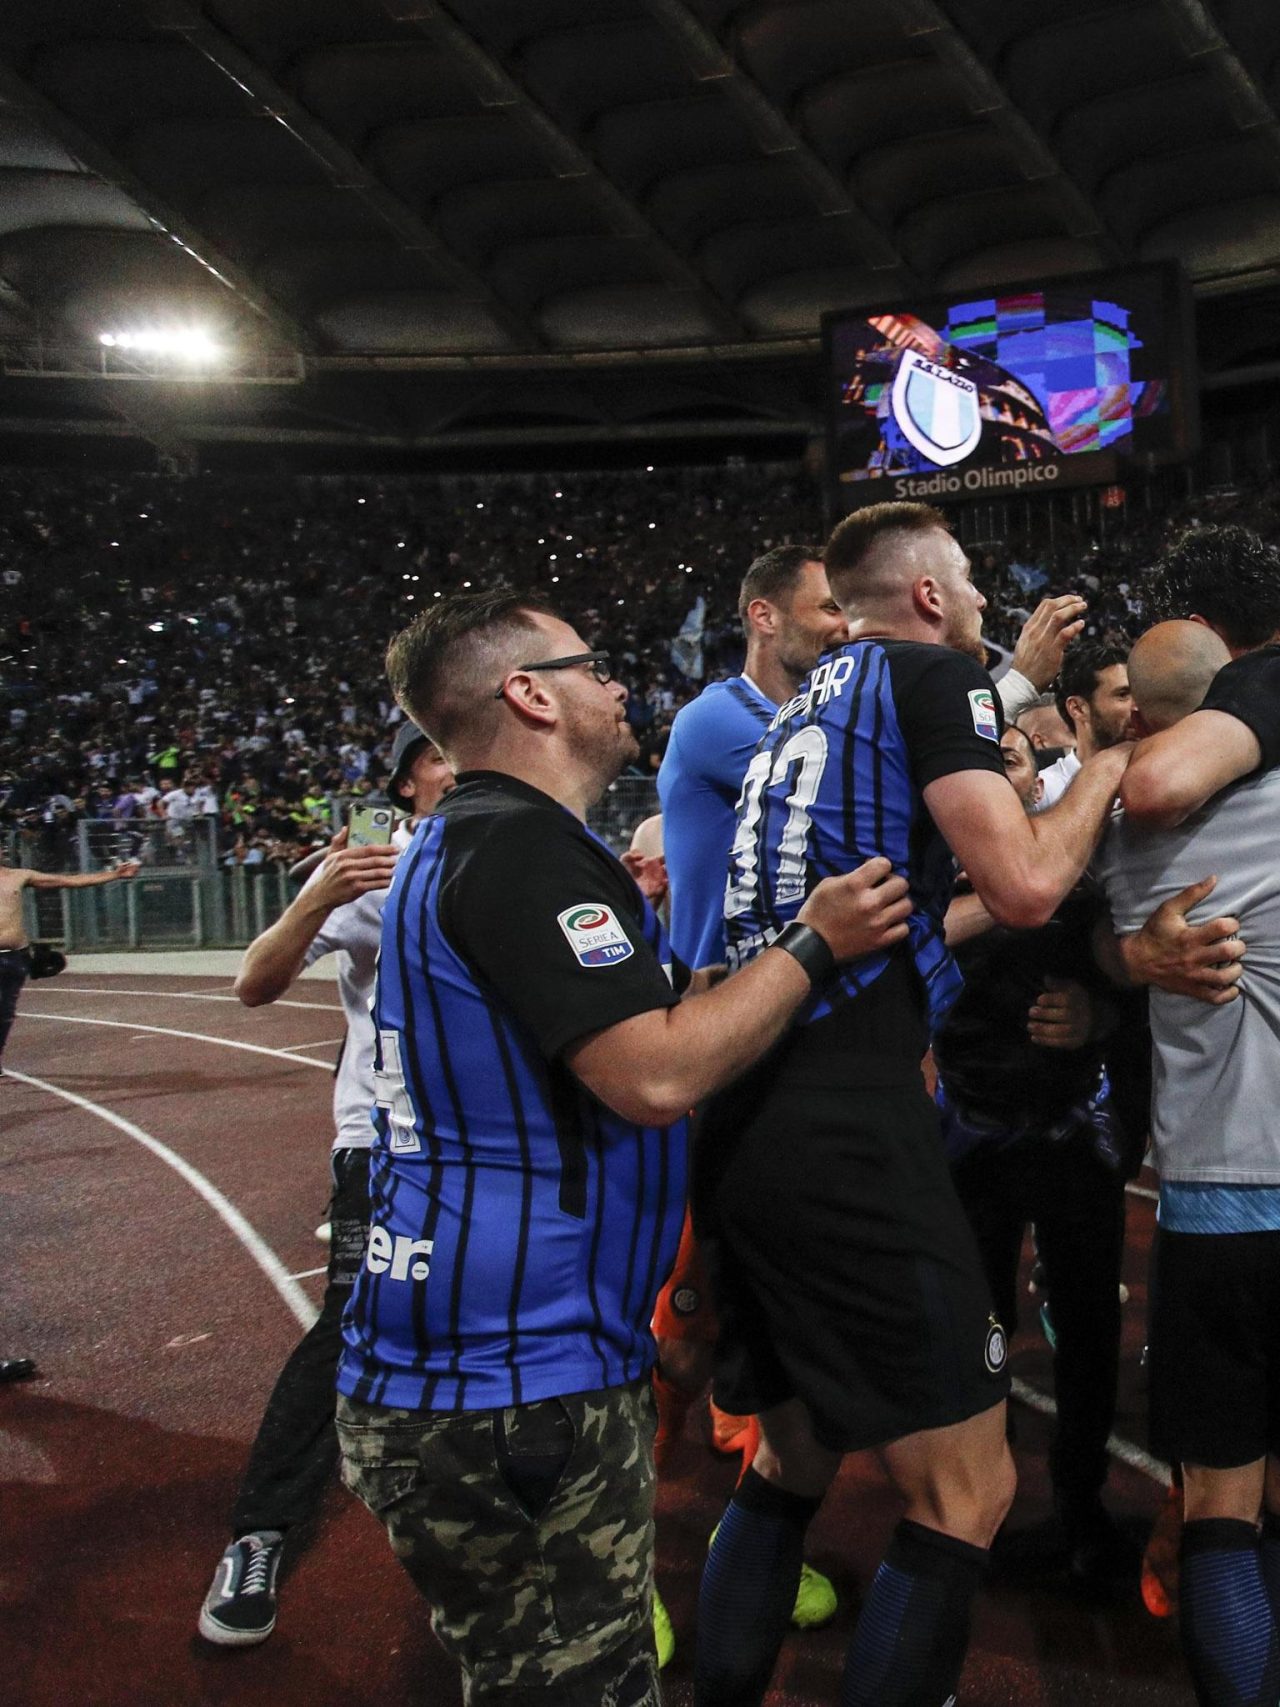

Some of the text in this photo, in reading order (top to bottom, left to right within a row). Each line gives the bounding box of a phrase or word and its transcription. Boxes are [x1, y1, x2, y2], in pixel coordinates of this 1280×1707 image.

[895, 463, 1059, 499] Stadio Olimpico
[579, 933, 608, 948] SERIE
[601, 945, 626, 958] TIM
